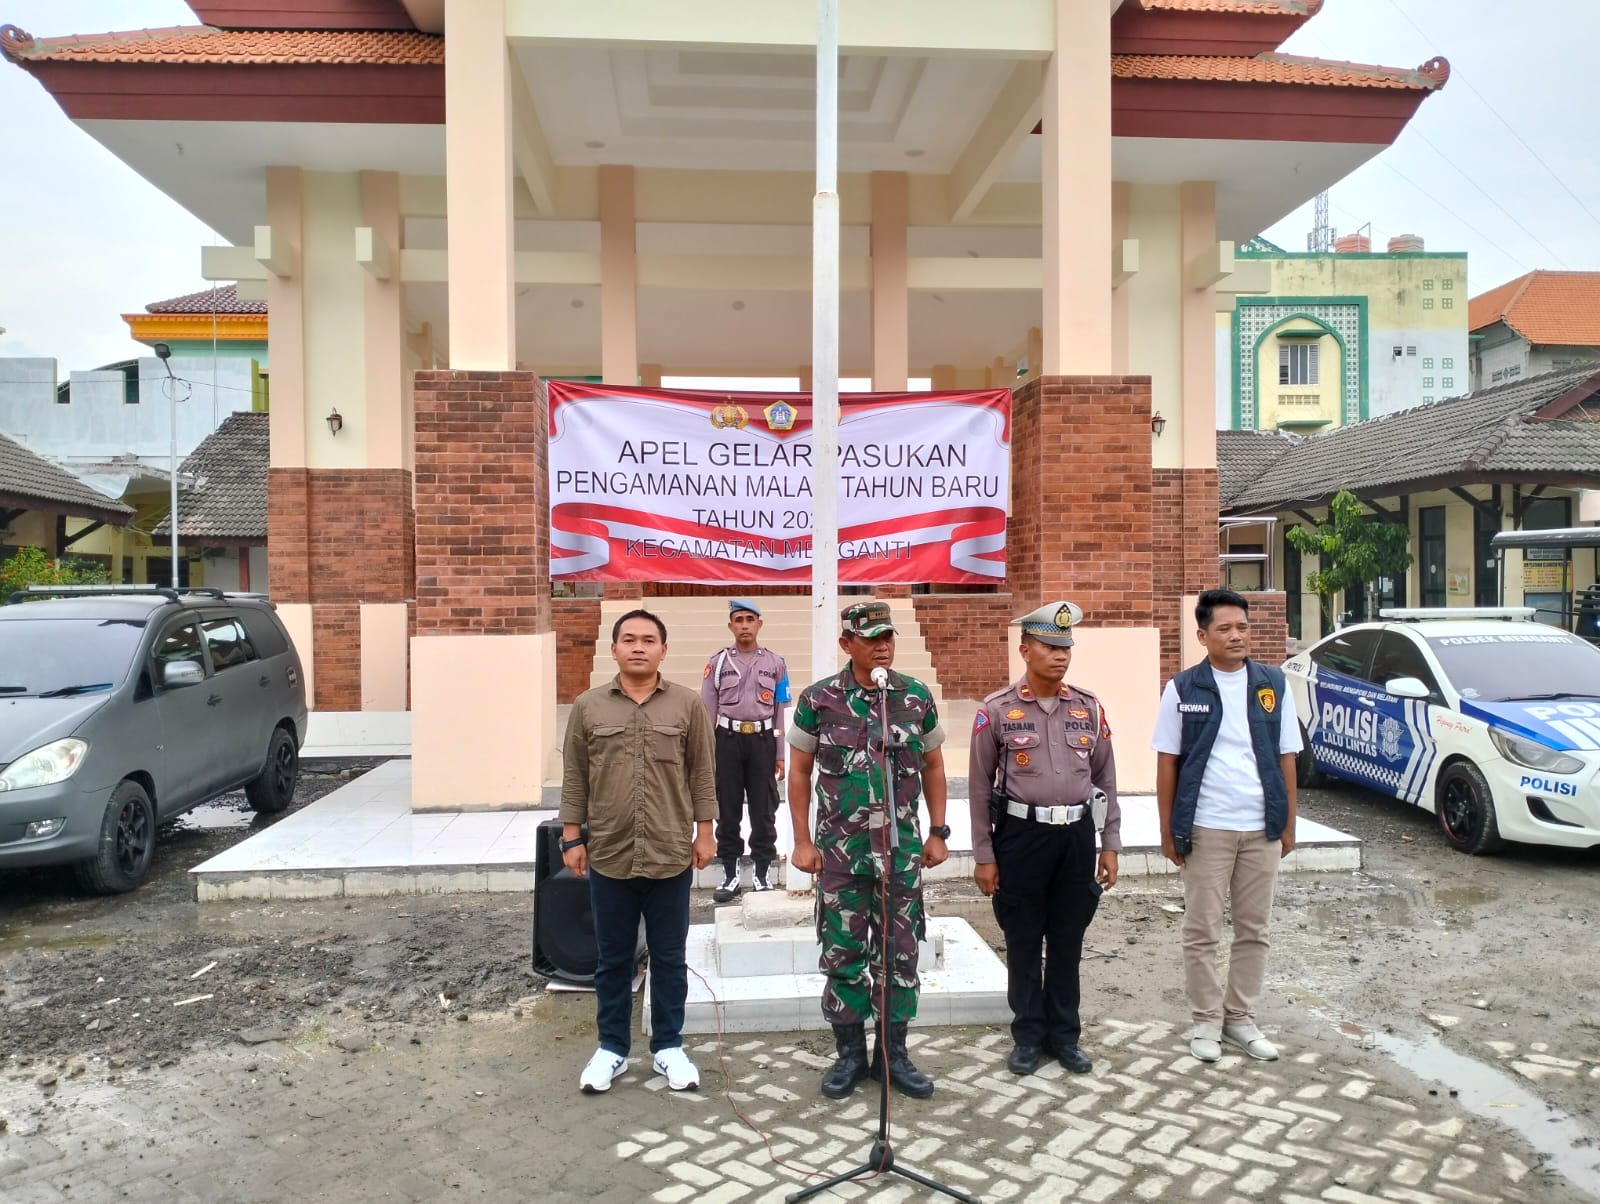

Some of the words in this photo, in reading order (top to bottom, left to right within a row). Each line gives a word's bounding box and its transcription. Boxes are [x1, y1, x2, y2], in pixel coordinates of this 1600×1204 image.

[617, 439, 699, 466] APEL
[707, 442, 812, 467] GELAR
[556, 470, 737, 497] PENGAMANAN
[746, 474, 813, 498] MALA
[841, 475, 923, 498] TAHUN
[931, 475, 999, 498] BARU
[691, 508, 775, 529] TAHUN
[625, 538, 775, 559] KECAMATAN
[783, 540, 912, 560] MEGANTI
[1439, 635, 1498, 646] POLSEK
[1179, 703, 1210, 713] EKWAN
[1322, 702, 1378, 743] POLISI
[1322, 731, 1344, 748] LALU
[1345, 738, 1378, 758] LINTAS
[1519, 775, 1578, 797] POLISI
